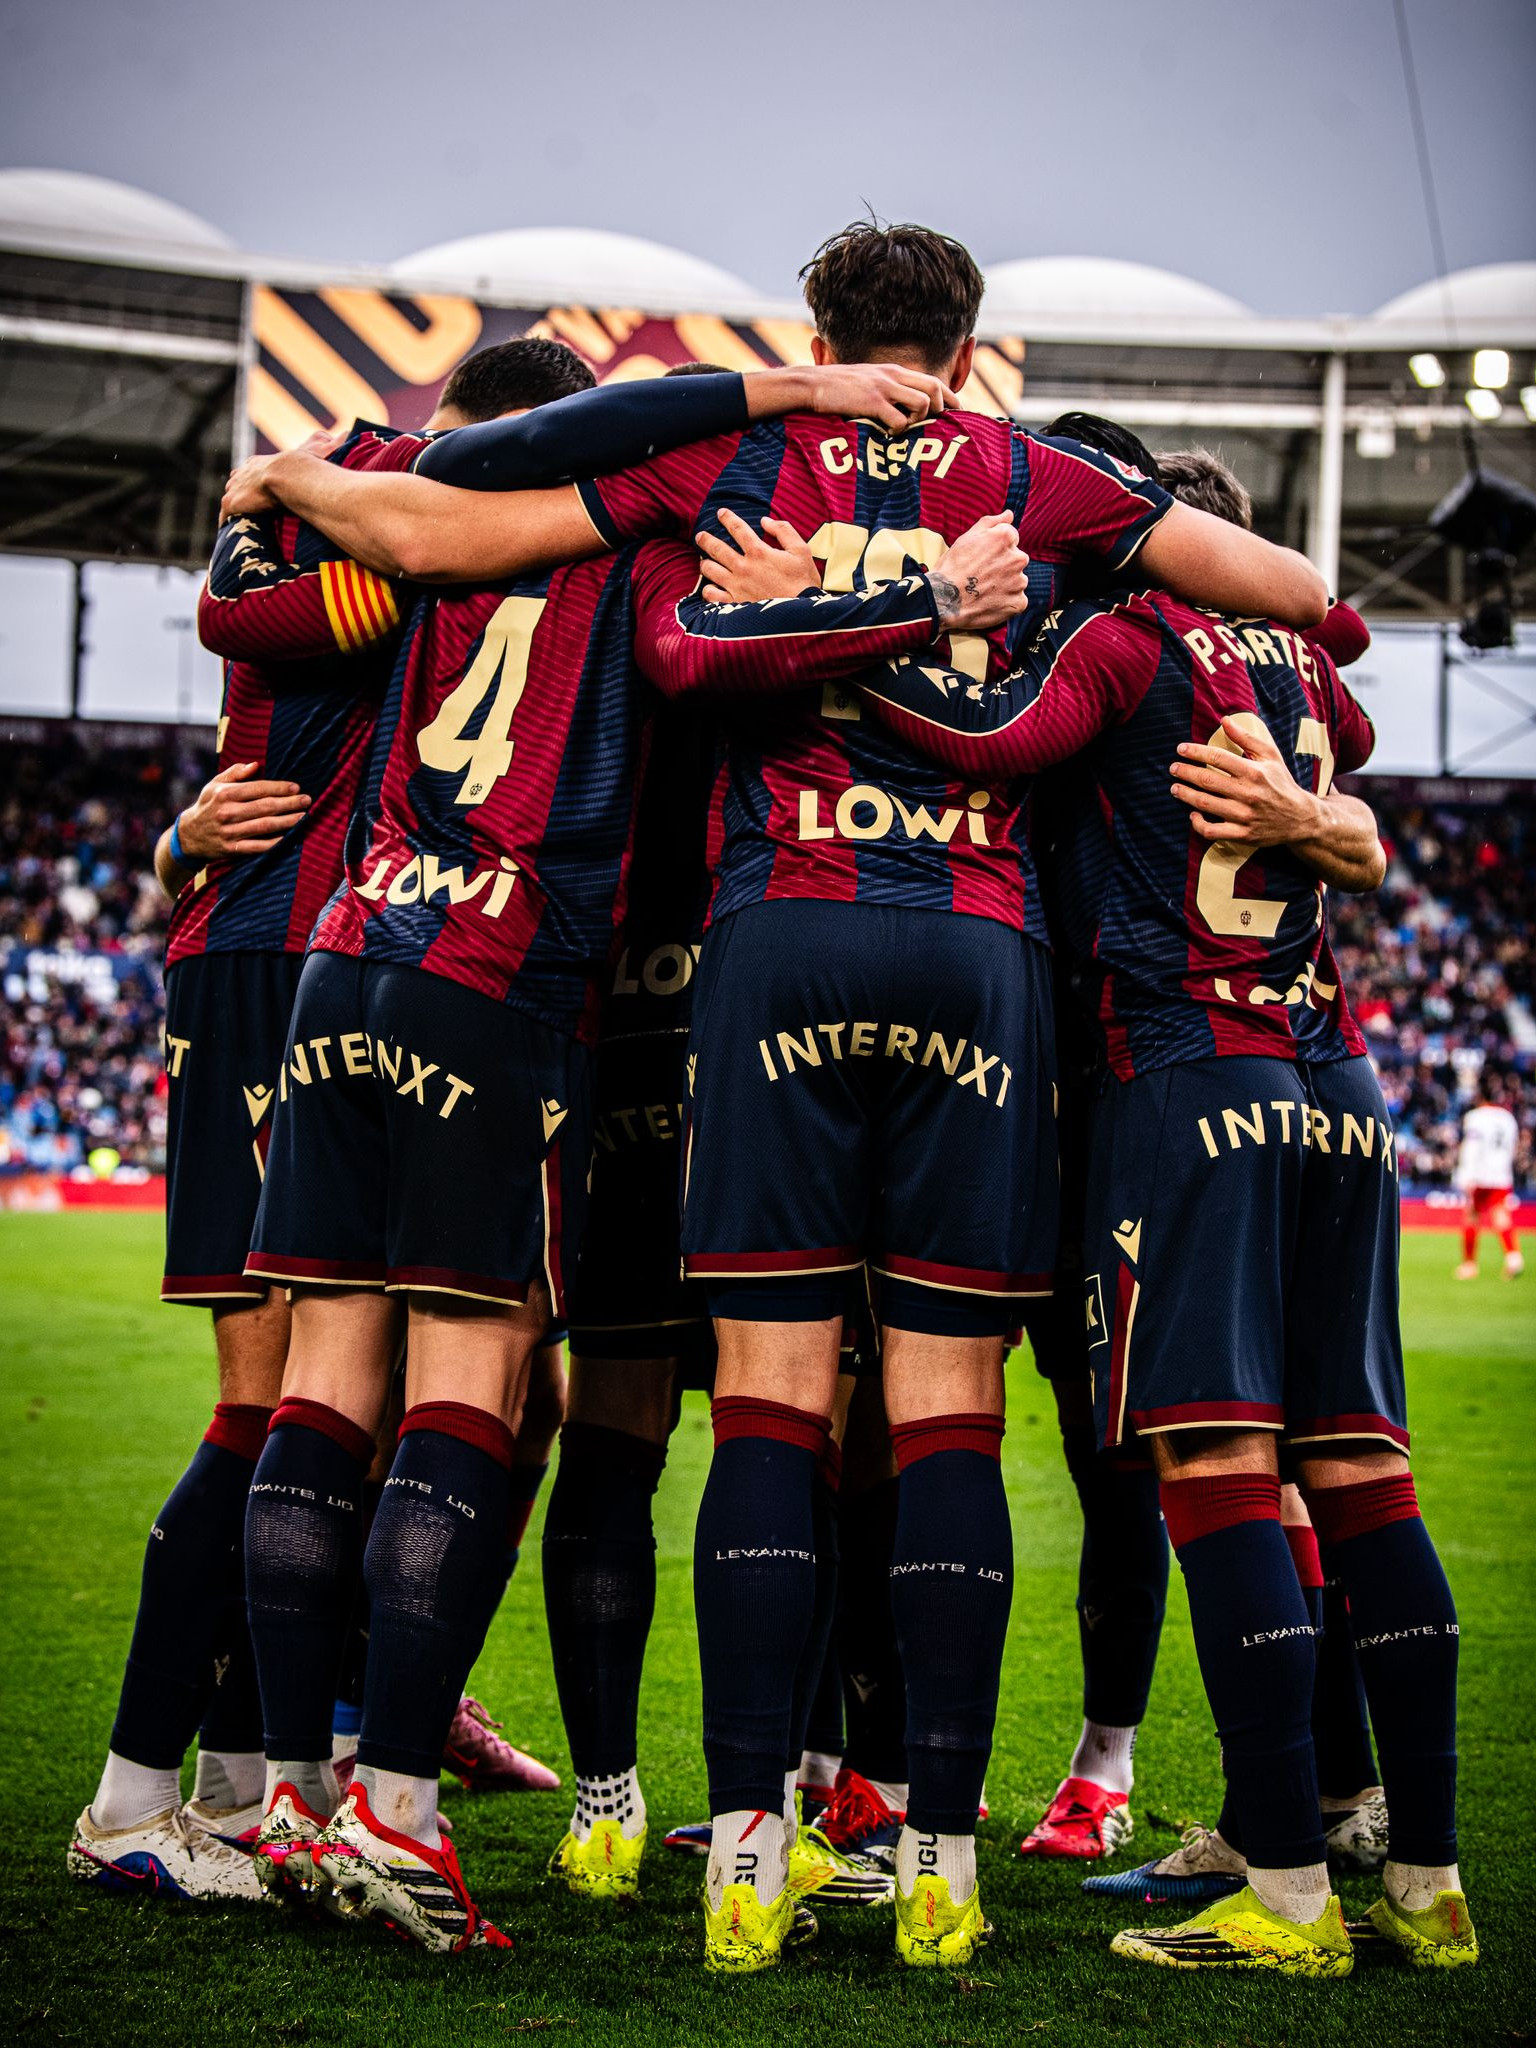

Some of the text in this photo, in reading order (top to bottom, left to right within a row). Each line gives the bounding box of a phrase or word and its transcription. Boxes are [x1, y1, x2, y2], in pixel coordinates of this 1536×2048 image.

[416, 596, 548, 805] 4
[280, 1031, 476, 1119] INTENXT
[758, 1021, 1012, 1108] INTERNXT
[1197, 1100, 1399, 1183] INTERNX
